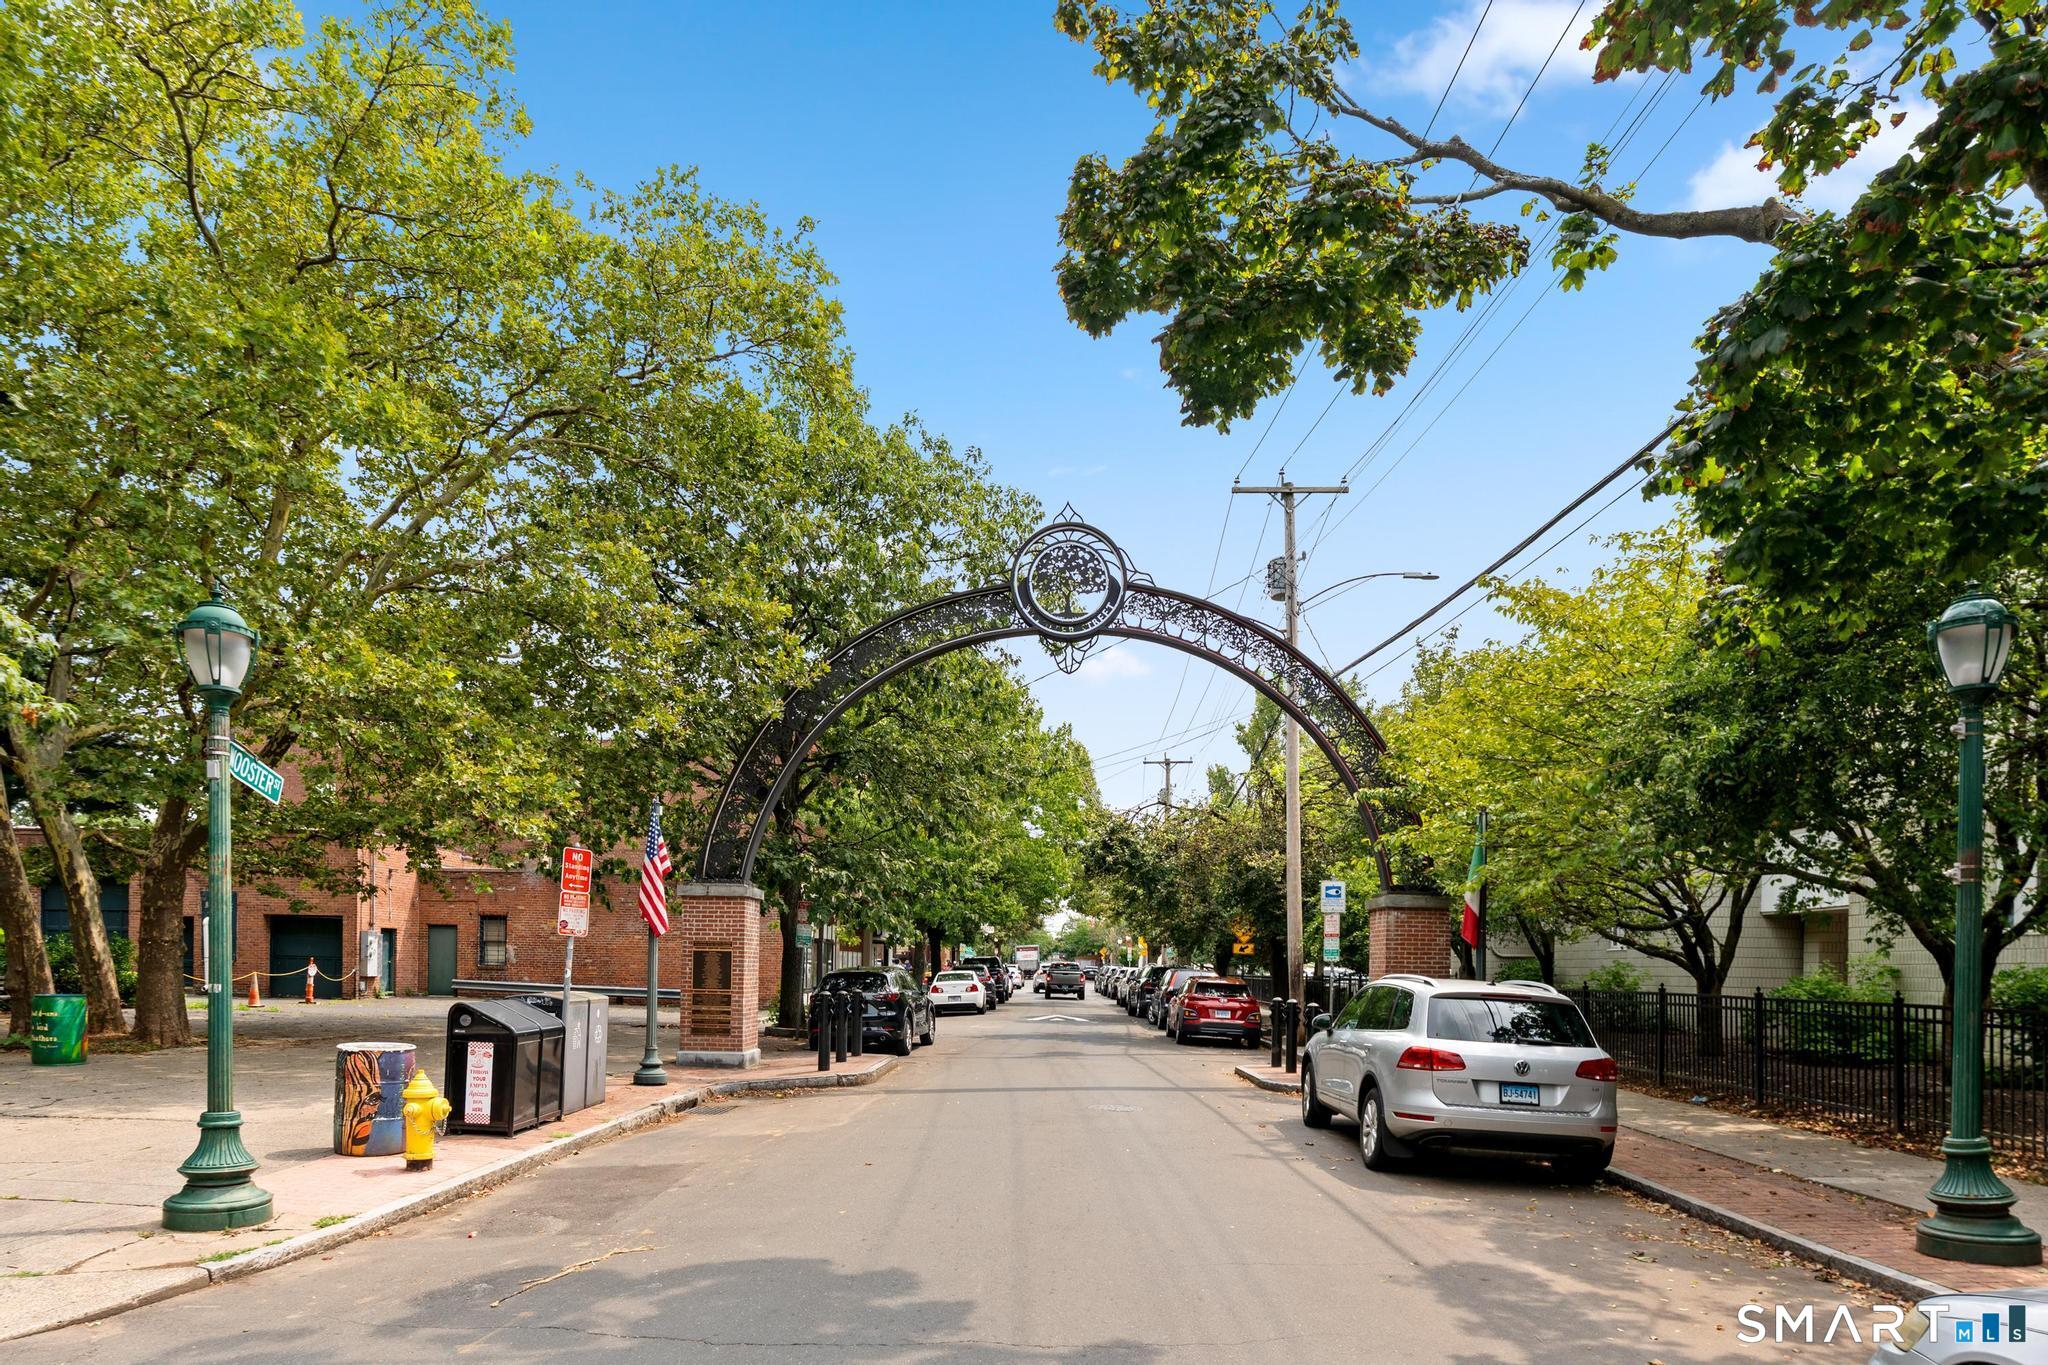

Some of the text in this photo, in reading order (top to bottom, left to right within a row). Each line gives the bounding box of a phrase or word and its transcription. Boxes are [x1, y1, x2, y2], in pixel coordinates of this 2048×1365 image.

[571, 852, 584, 862] NO
[565, 862, 590, 873] Standing
[564, 872, 588, 882] Anytime
